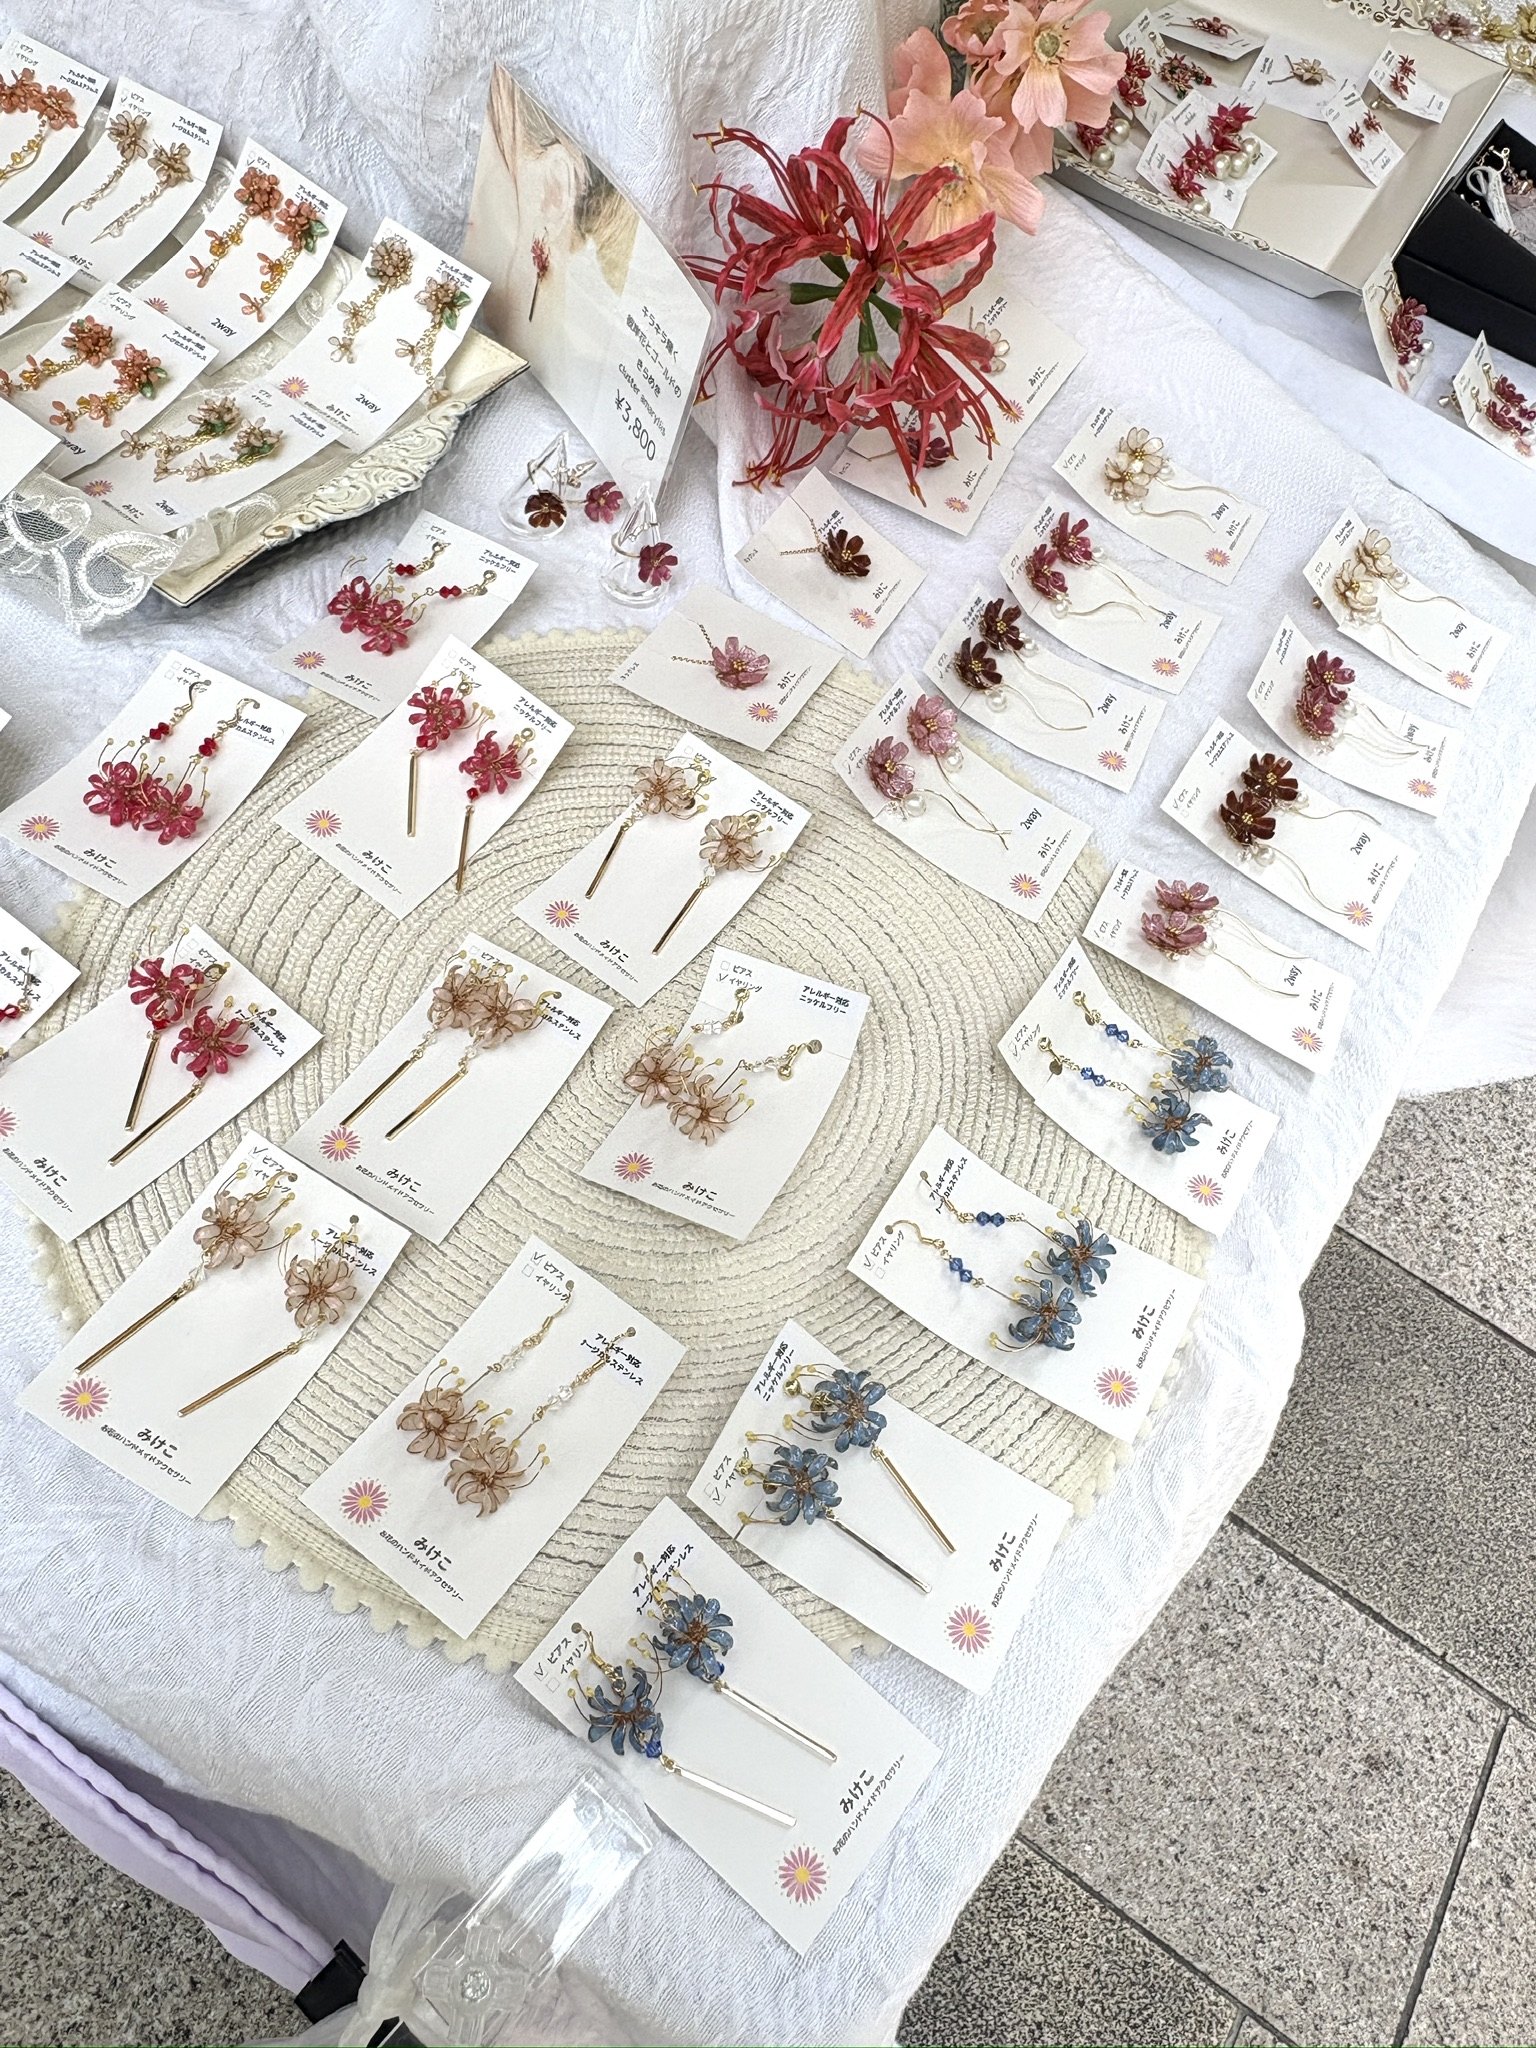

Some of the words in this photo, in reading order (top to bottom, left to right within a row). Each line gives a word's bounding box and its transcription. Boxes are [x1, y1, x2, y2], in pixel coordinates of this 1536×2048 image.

[210, 318, 238, 338] 2way
[637, 358, 661, 398] きらめき
[355, 393, 382, 413] 2way
[615, 389, 656, 461] ¥3,800
[458, 656, 477, 673] ピアス
[344, 673, 374, 690] みけこ
[1097, 693, 1118, 715] 2way
[750, 796, 790, 827] ニッケルフリー
[1020, 806, 1043, 832] 2way
[1037, 836, 1057, 859] みけこ
[1350, 832, 1372, 856] 2way
[82, 847, 118, 868] みけこ
[361, 848, 393, 875] みけこ
[1367, 862, 1385, 885] みけこ
[599, 938, 630, 964] みけこ
[732, 964, 753, 979] ピアス
[1284, 964, 1302, 988] 2way
[799, 994, 848, 1016] ニッケルフリー
[802, 984, 851, 1009] アレルギー対応
[1309, 989, 1324, 1012] みけこ
[1015, 1023, 1029, 1044] ピアス
[1216, 1129, 1238, 1156] みけこ
[33, 1156, 68, 1188] みけこ
[385, 1166, 423, 1193] みけこ
[682, 1180, 719, 1202] みけこ
[870, 1235, 888, 1259] ピアス
[881, 1230, 906, 1266] イヤリング
[542, 1261, 566, 1282] ピアス
[534, 1273, 572, 1302] イヤリング
[1130, 1304, 1157, 1341] みけこ
[753, 1342, 790, 1396] アレルギー対応
[762, 1348, 797, 1402] ニッケルフリー
[135, 1426, 180, 1460] みけこ
[712, 1454, 733, 1482] ピアス
[412, 1534, 455, 1573] みけこ
[988, 1530, 1018, 1573] みけこ
[547, 1637, 572, 1665] ピアス
[560, 1640, 589, 1675] イヤリン
[839, 1769, 875, 1815] みけこ
